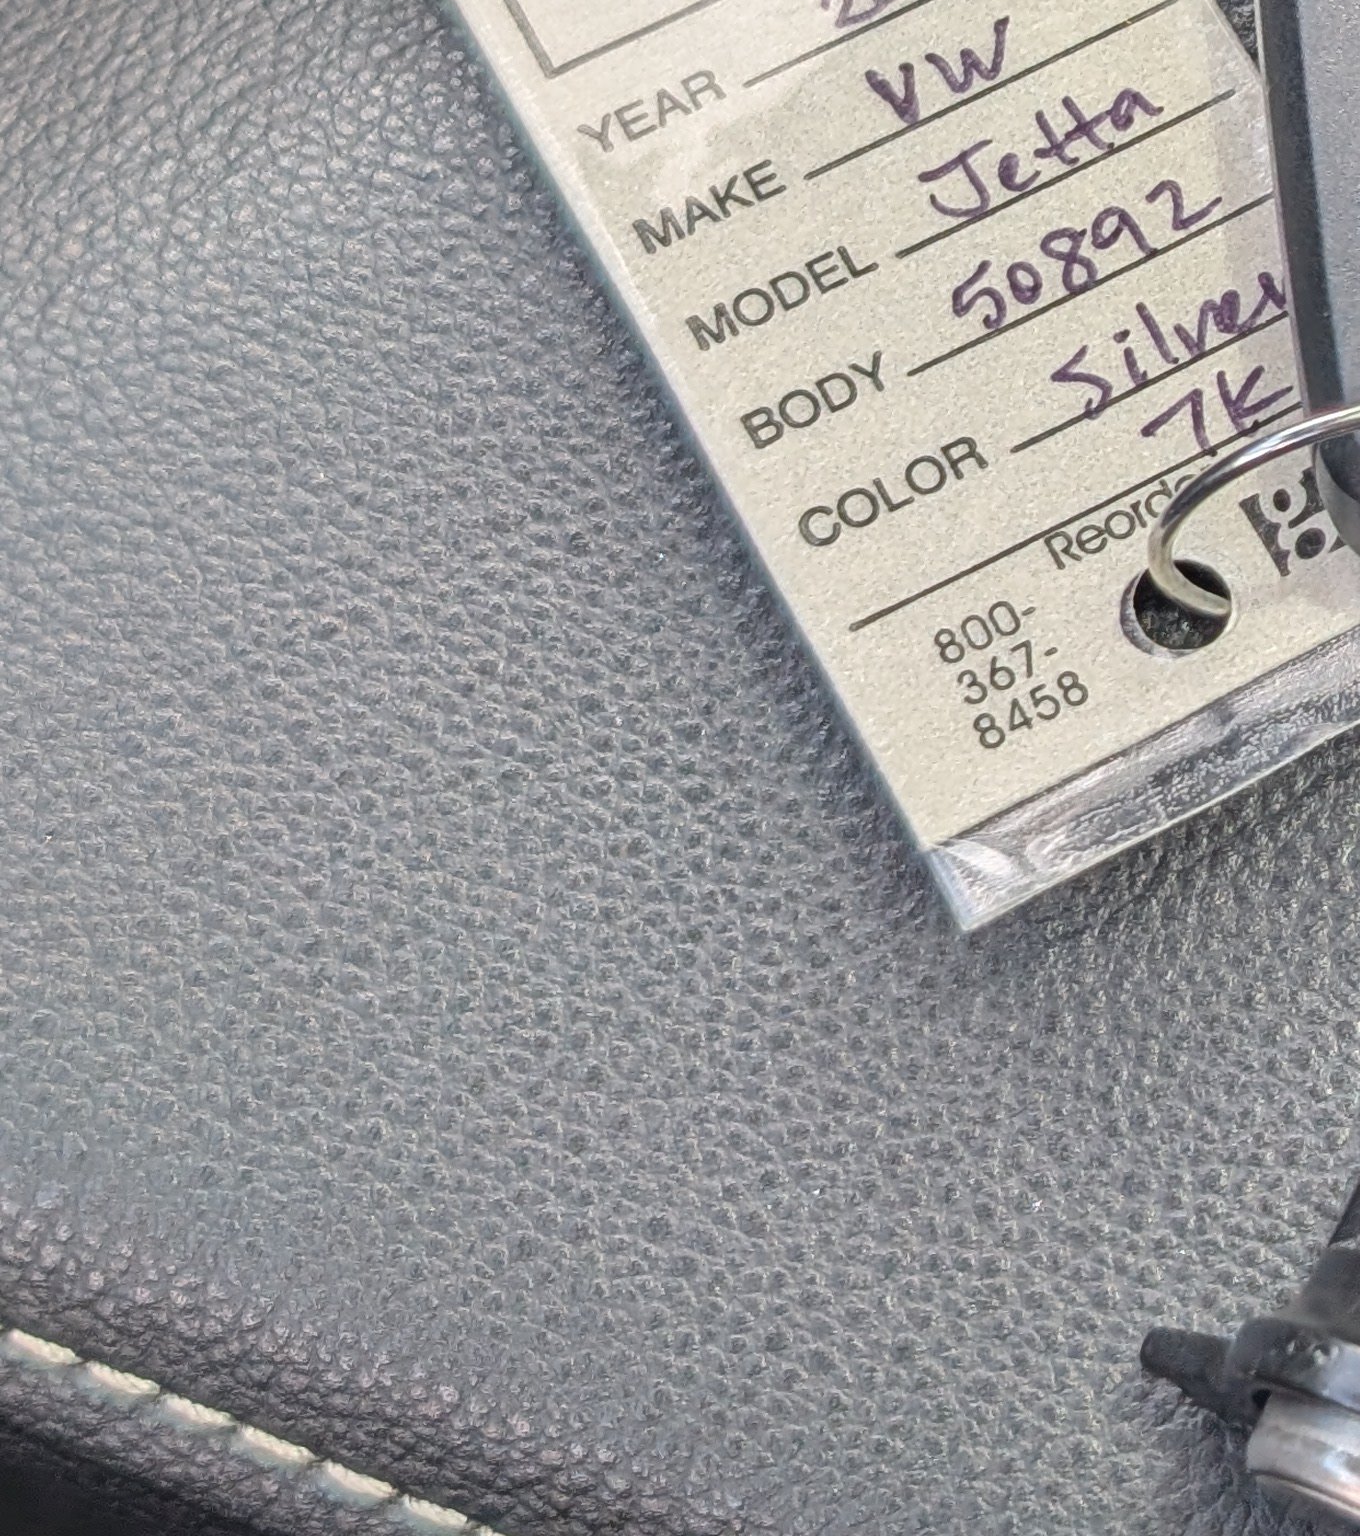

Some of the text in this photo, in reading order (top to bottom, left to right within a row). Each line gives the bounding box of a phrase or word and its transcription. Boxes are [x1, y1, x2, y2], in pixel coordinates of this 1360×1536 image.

[578, 68, 726, 153] YEAR
[866, 16, 1009, 123] VW
[919, 88, 1164, 218] Jetta
[632, 160, 786, 253] MAKE
[952, 180, 1222, 330] 50892
[686, 245, 878, 350] MODEL
[1051, 272, 1286, 420] Silver
[739, 351, 891, 450] BODY
[798, 436, 989, 547] COLOR
[1044, 474, 1196, 570] Reord
[934, 600, 1036, 665] 800-
[956, 642, 1058, 707] 367-
[974, 671, 1091, 748] 8458
